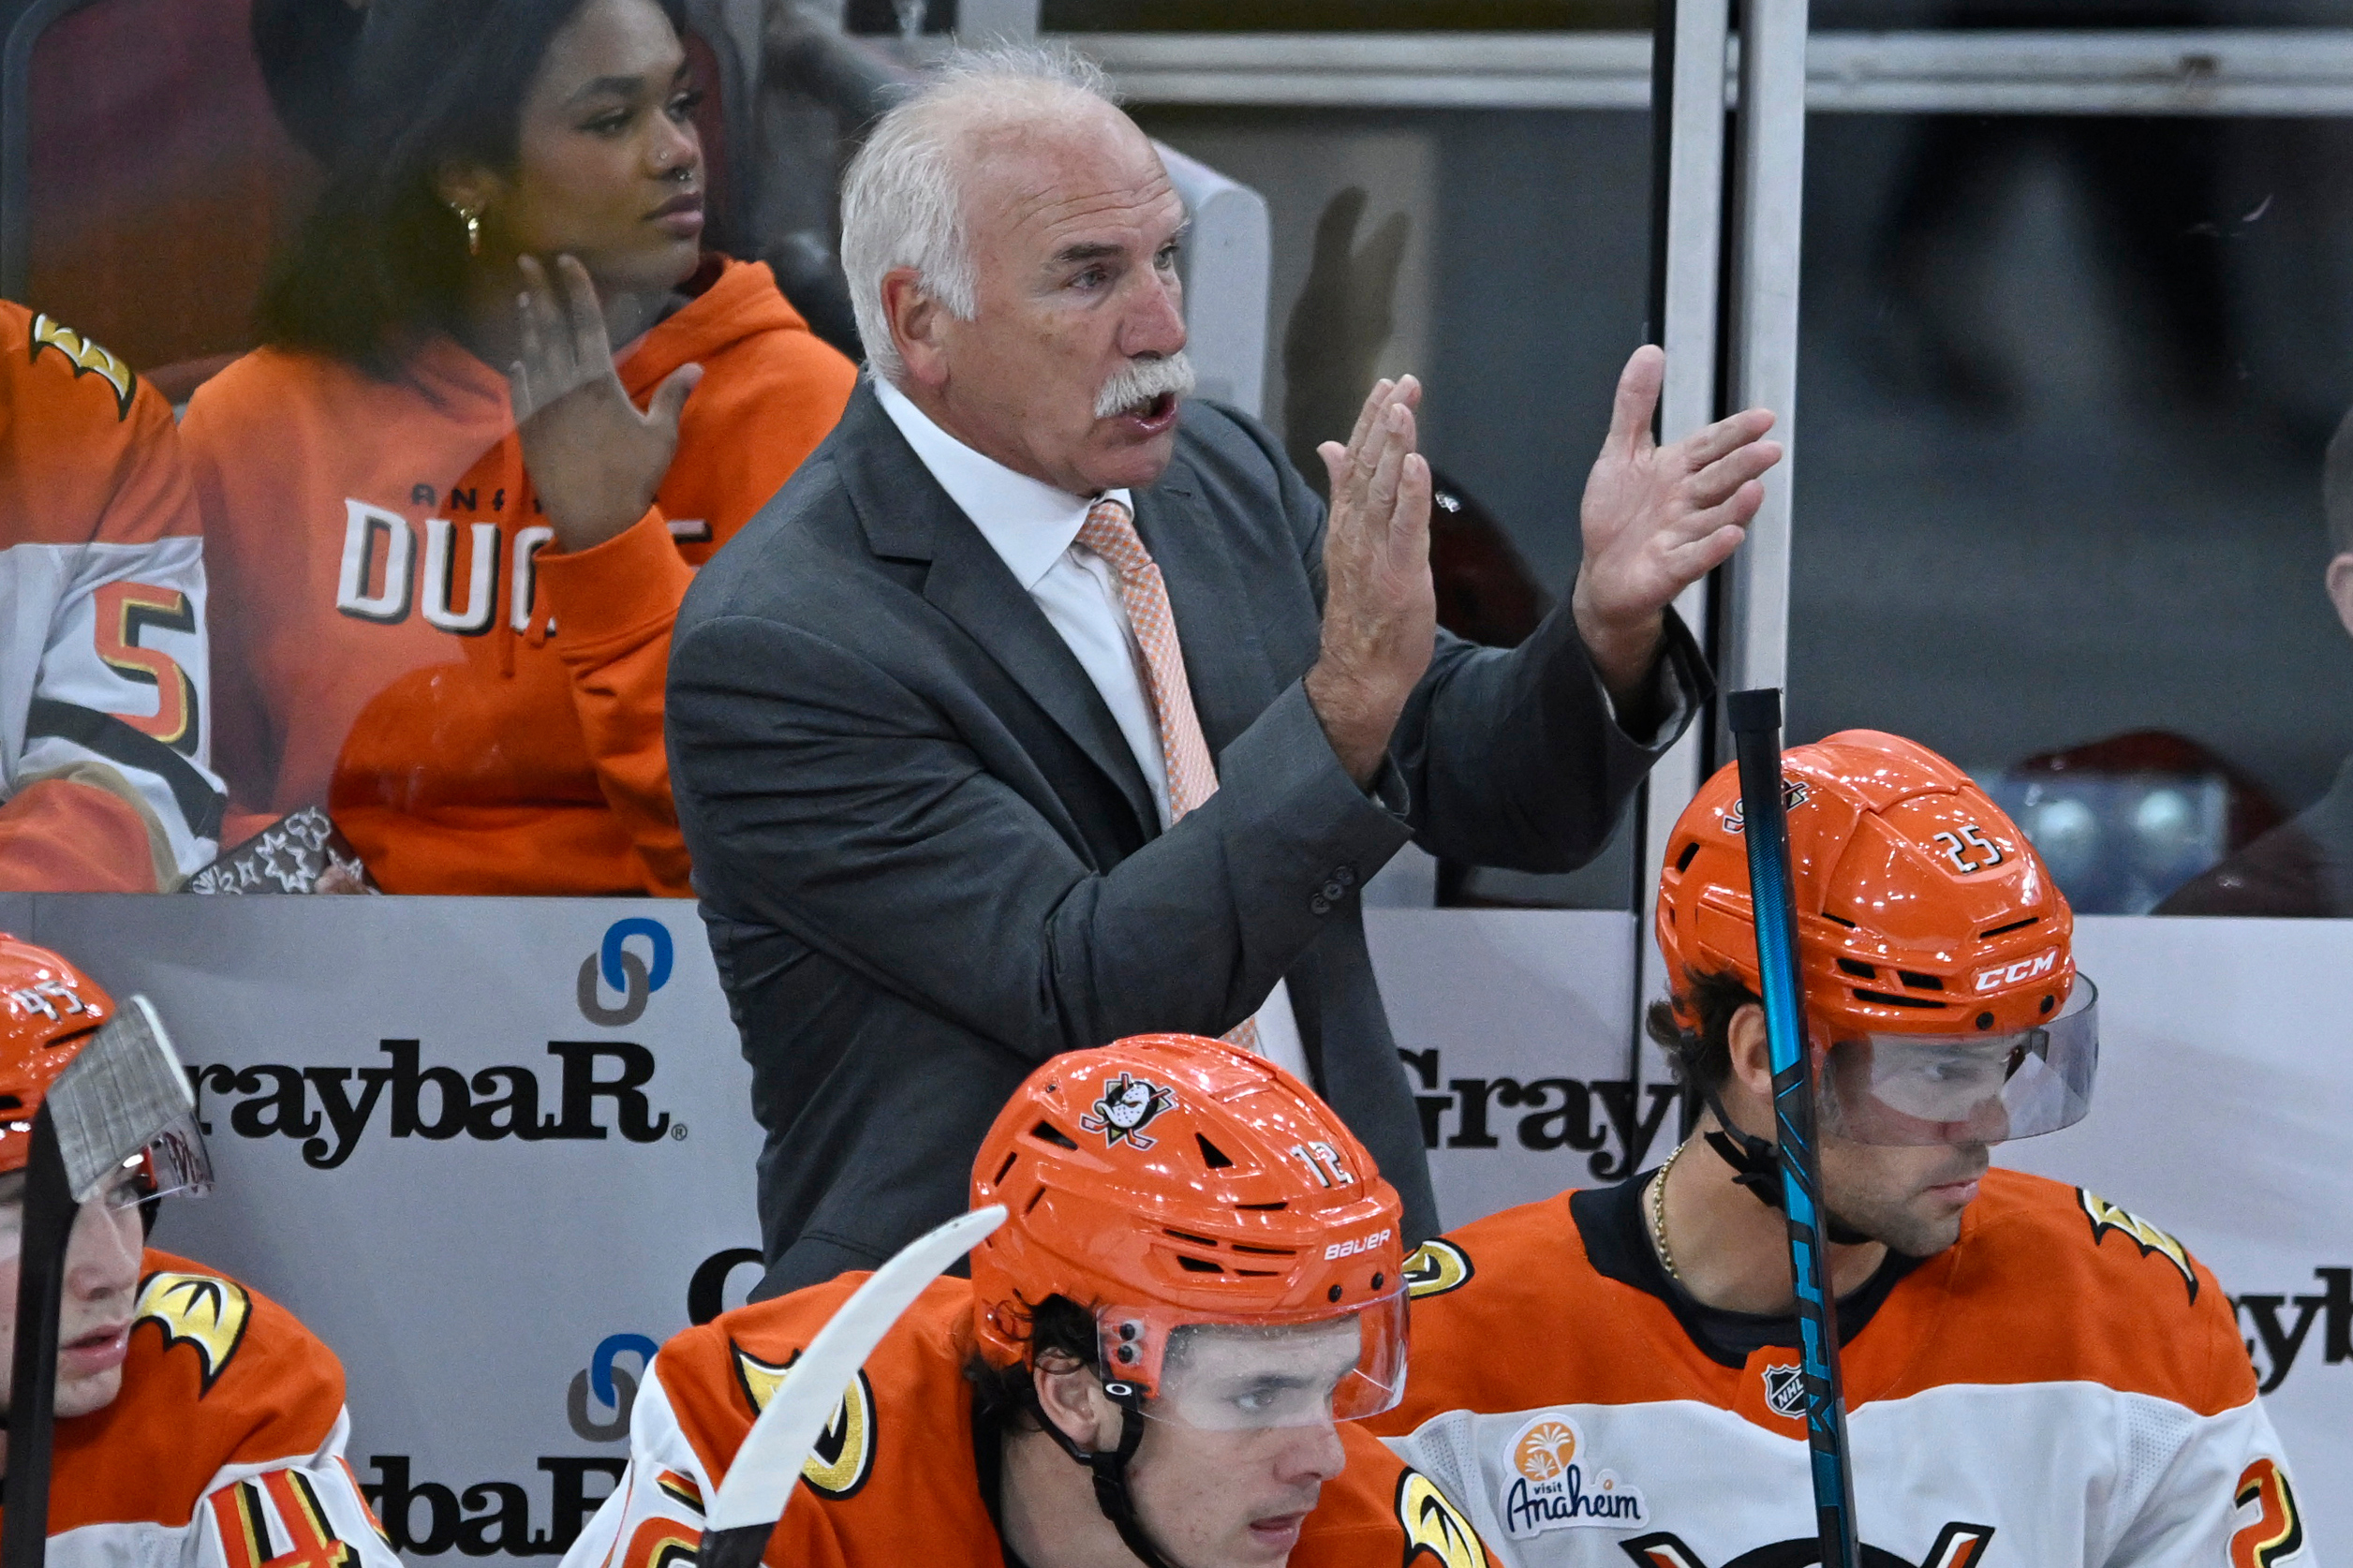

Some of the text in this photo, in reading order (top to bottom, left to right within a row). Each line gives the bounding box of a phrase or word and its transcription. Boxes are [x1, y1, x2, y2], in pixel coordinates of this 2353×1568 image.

[1932, 823, 2004, 874] 25
[1975, 950, 2057, 991] CCM
[10, 980, 85, 1022] 45
[185, 1039, 670, 1169] raybaR
[1290, 1141, 1354, 1189] 12
[1776, 1374, 1806, 1409] NHL
[1506, 1463, 1642, 1533] Anaheim
[1533, 1481, 1563, 1496] visit
